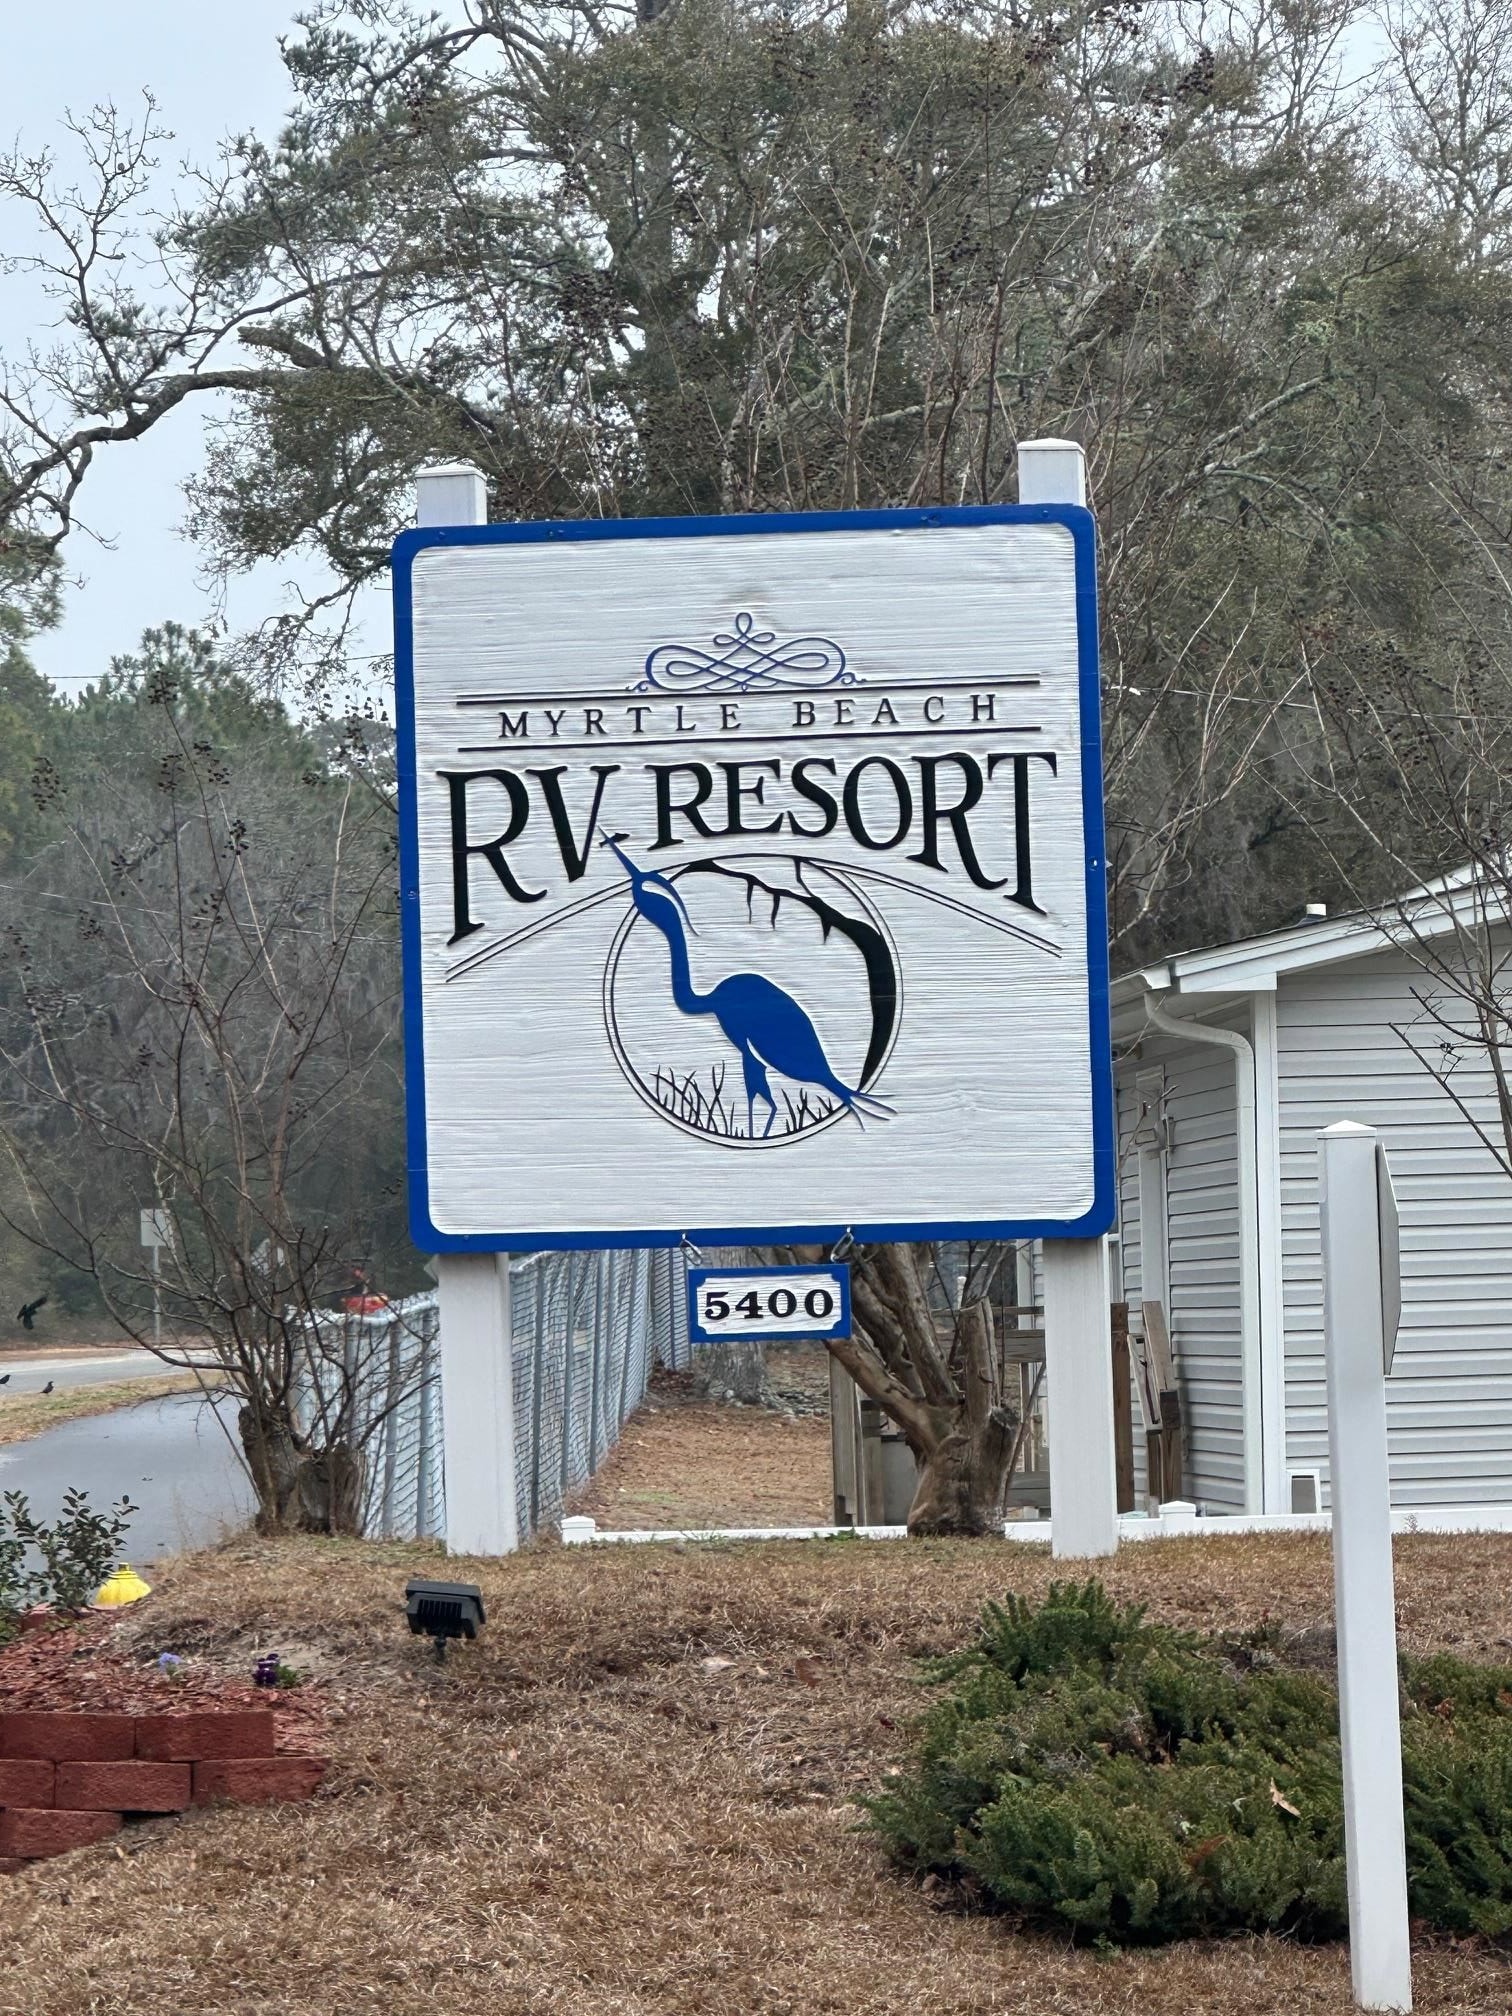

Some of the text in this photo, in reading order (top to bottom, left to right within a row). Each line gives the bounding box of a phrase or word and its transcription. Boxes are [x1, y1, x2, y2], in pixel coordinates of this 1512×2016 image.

[499, 694, 998, 738] MYRTLE BEACH
[436, 751, 1058, 946] RV RESORT
[704, 1288, 834, 1321] 5400
